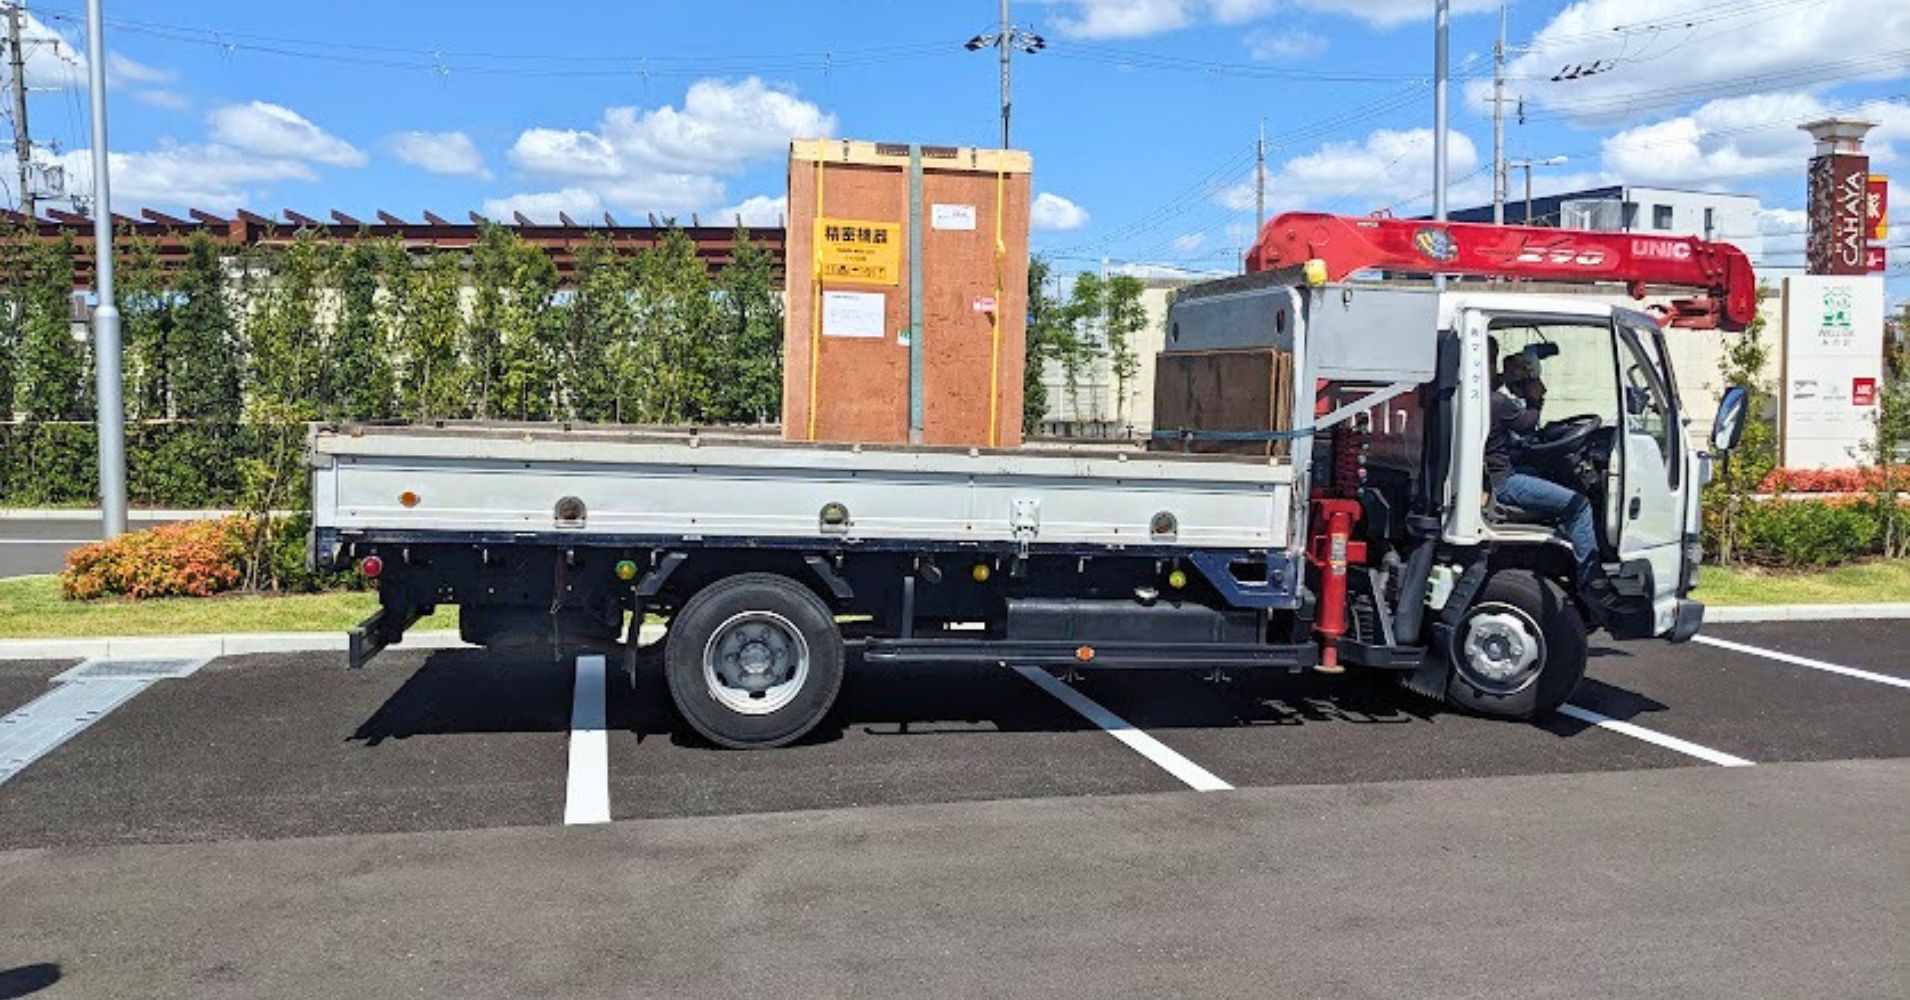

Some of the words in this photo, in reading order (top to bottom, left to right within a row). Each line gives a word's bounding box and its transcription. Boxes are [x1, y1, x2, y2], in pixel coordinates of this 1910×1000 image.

[1843, 171, 1861, 266] CAHAYA
[825, 225, 887, 243] 精密機器
[1631, 239, 1692, 259] UNIC
